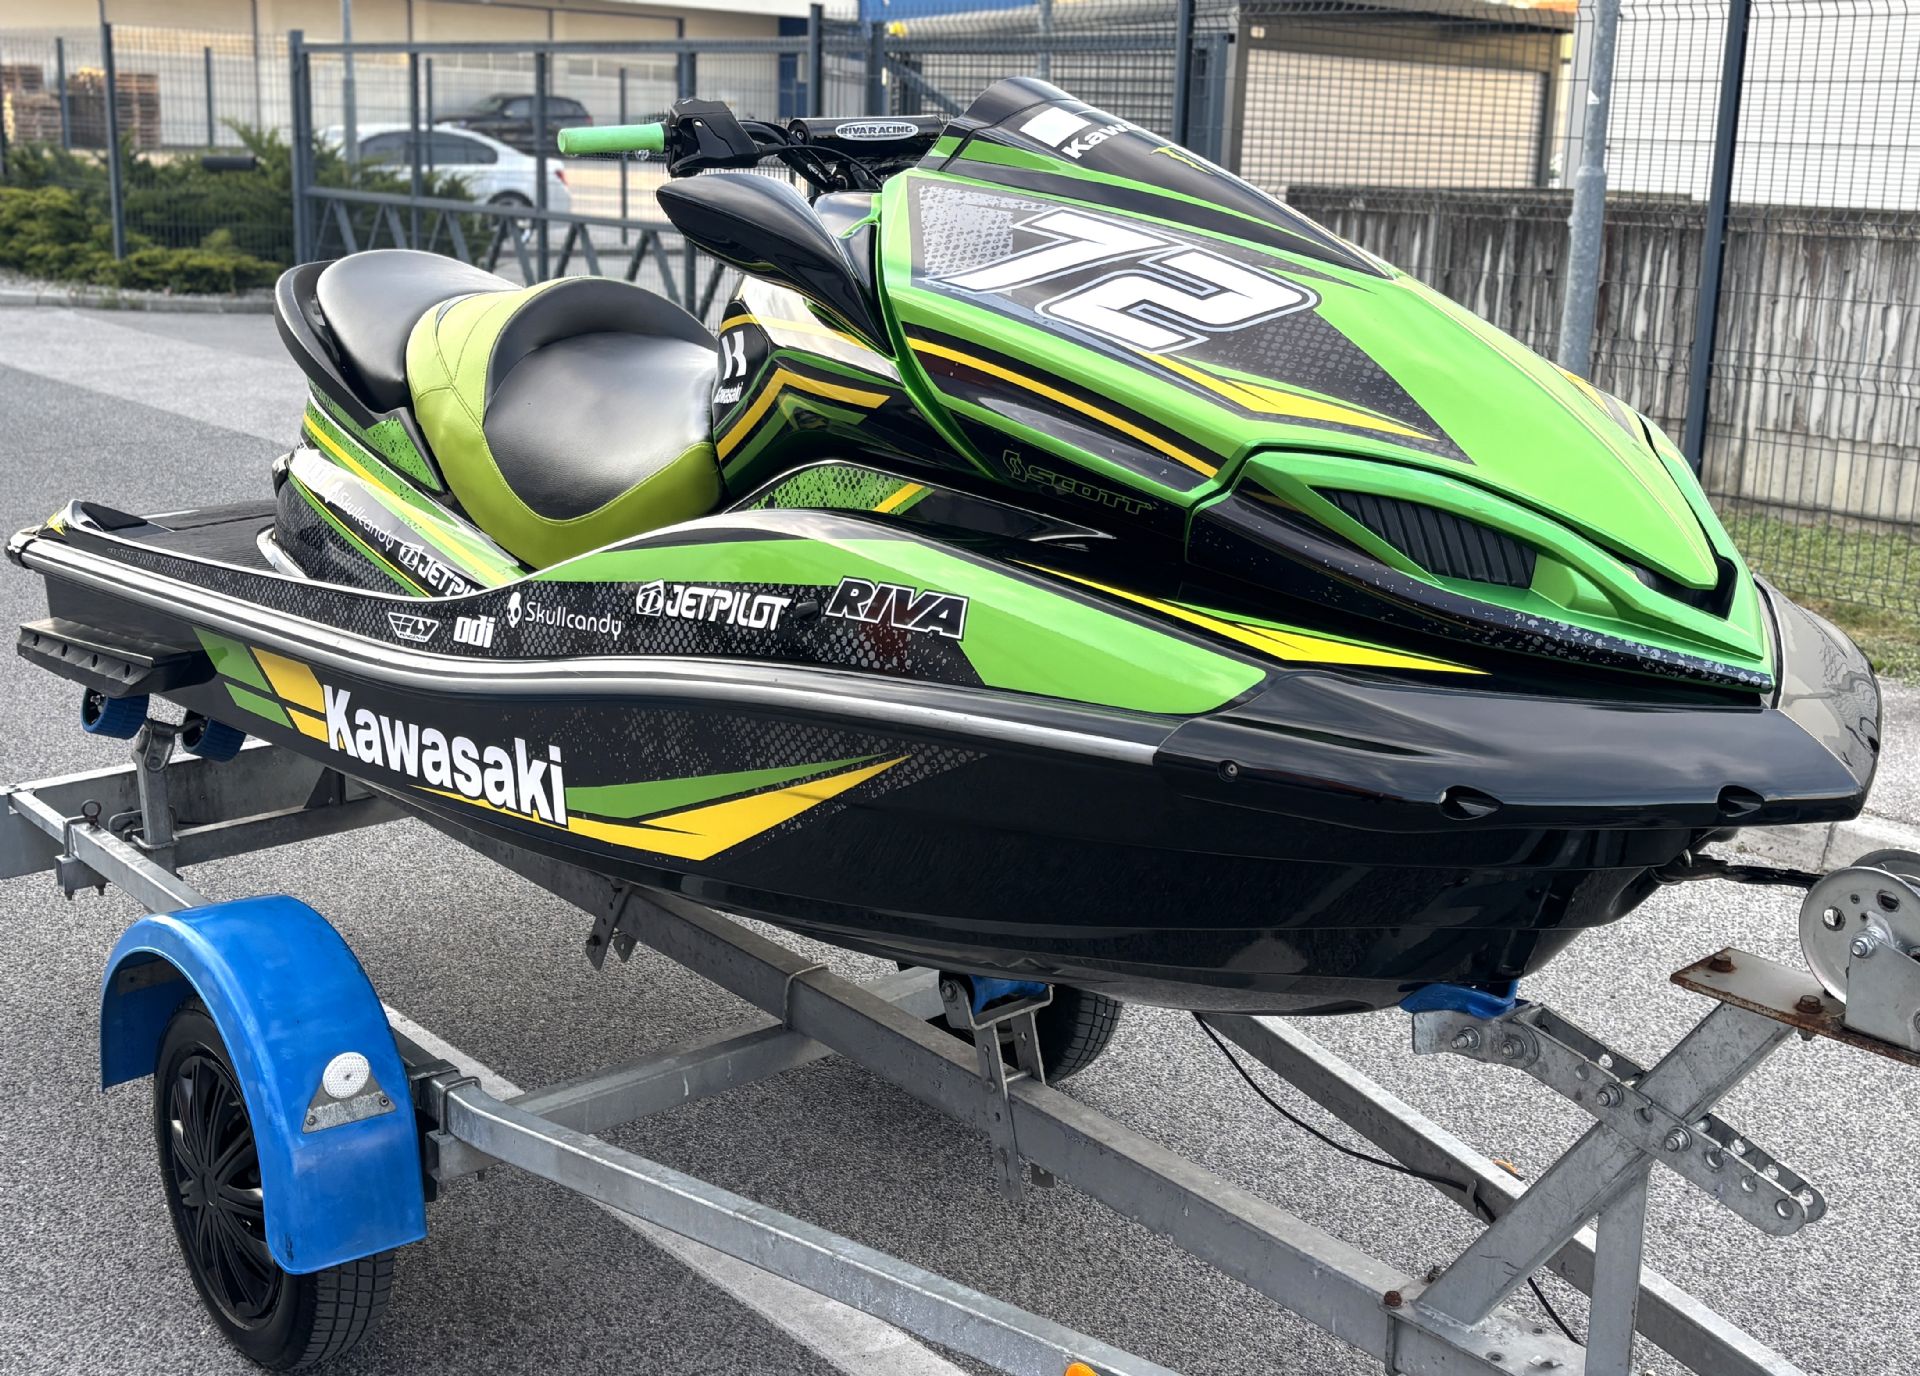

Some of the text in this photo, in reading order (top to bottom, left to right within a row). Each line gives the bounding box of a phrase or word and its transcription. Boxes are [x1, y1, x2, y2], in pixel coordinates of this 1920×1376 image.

[838, 126, 913, 135] RIVA RACING
[929, 207, 1320, 353] 72
[1026, 465, 1149, 515] SCOTT
[339, 491, 395, 552] Skullcandy
[525, 601, 622, 641] Skullcandy
[665, 584, 791, 630] JETPILOT
[826, 577, 969, 640] RIVA
[323, 684, 568, 826] Kawasaki
